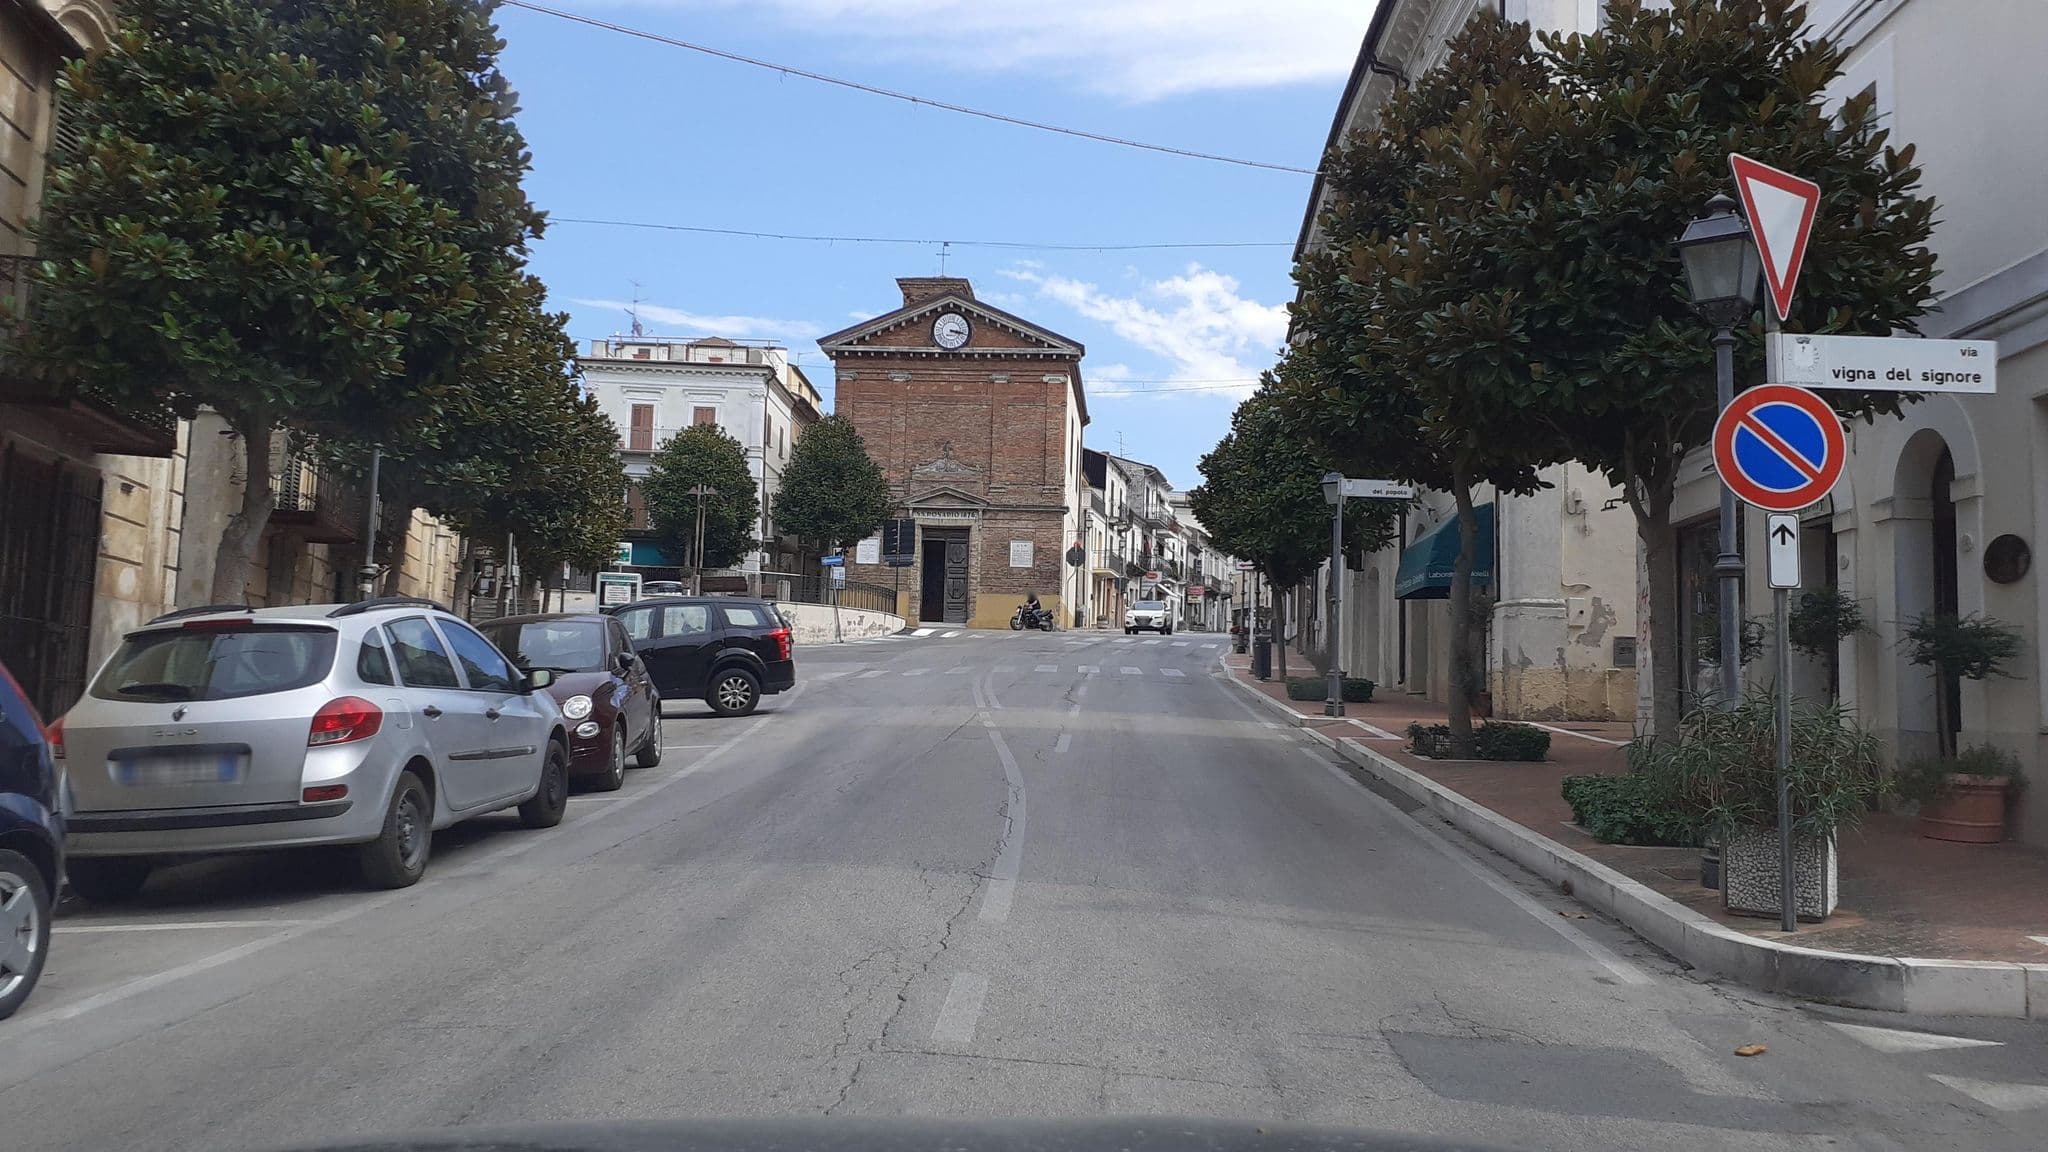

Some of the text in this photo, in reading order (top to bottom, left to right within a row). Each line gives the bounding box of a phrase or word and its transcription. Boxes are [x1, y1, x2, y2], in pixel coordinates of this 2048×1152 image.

[1959, 346, 1978, 358] via
[1831, 366, 1982, 385] vigna del signore
